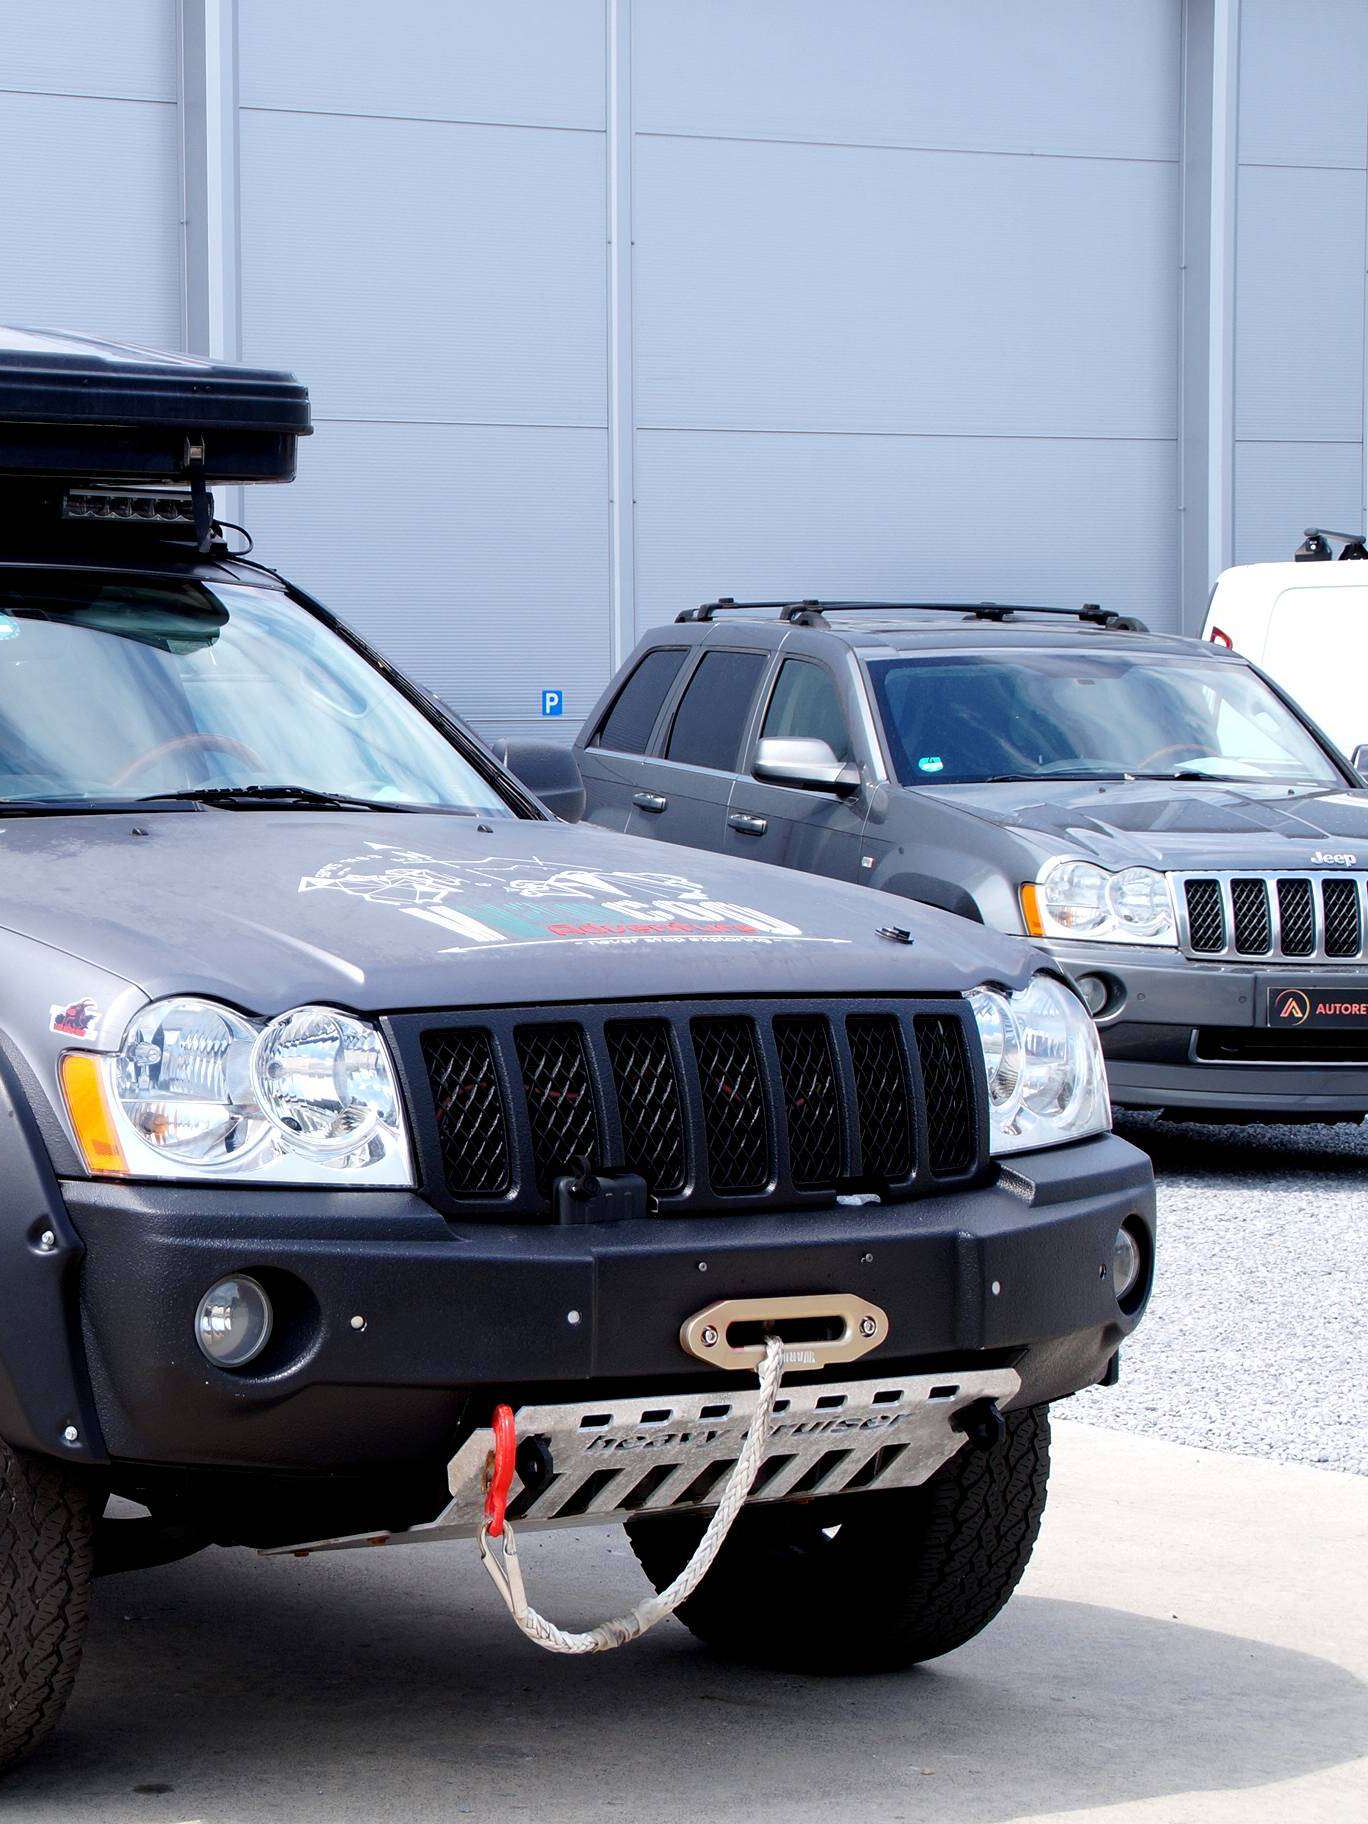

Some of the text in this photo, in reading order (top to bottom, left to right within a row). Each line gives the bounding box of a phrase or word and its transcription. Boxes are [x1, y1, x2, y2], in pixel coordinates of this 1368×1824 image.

[545, 693, 560, 714] P
[1310, 850, 1357, 867] Jeep
[1316, 1003, 1368, 1015] AUTORE
[585, 1429, 738, 1452] heavy
